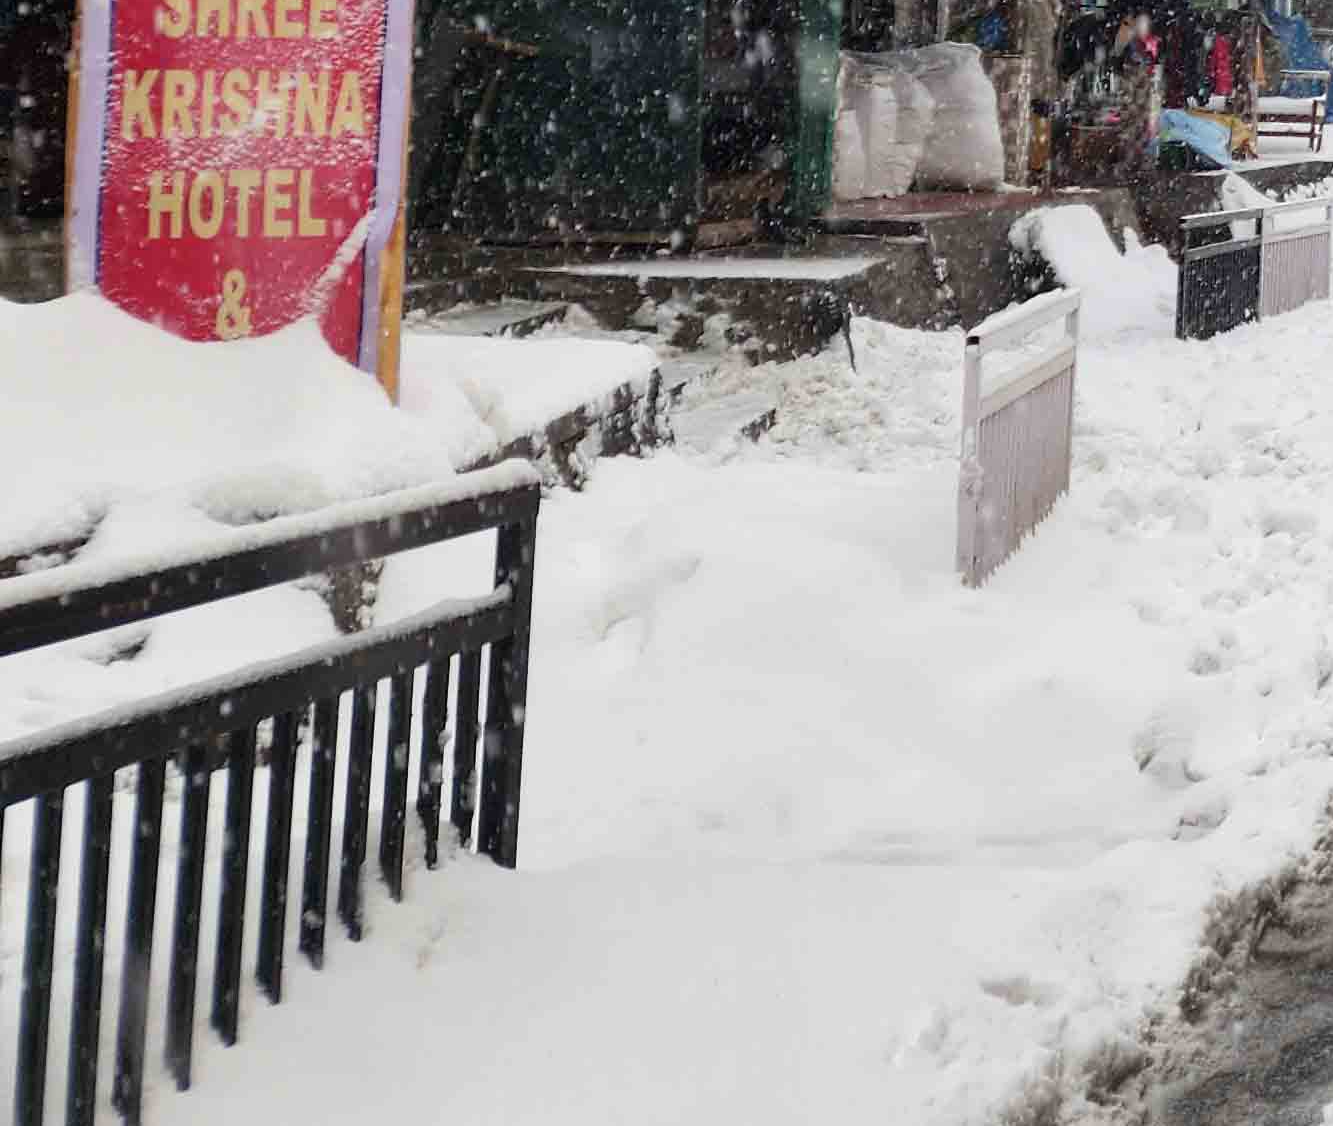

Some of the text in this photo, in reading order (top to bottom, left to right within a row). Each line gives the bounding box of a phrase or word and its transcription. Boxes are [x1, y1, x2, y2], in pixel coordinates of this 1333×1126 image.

[119, 69, 367, 140] KRISHNA
[147, 169, 327, 240] HOTEL
[215, 268, 253, 342] &
